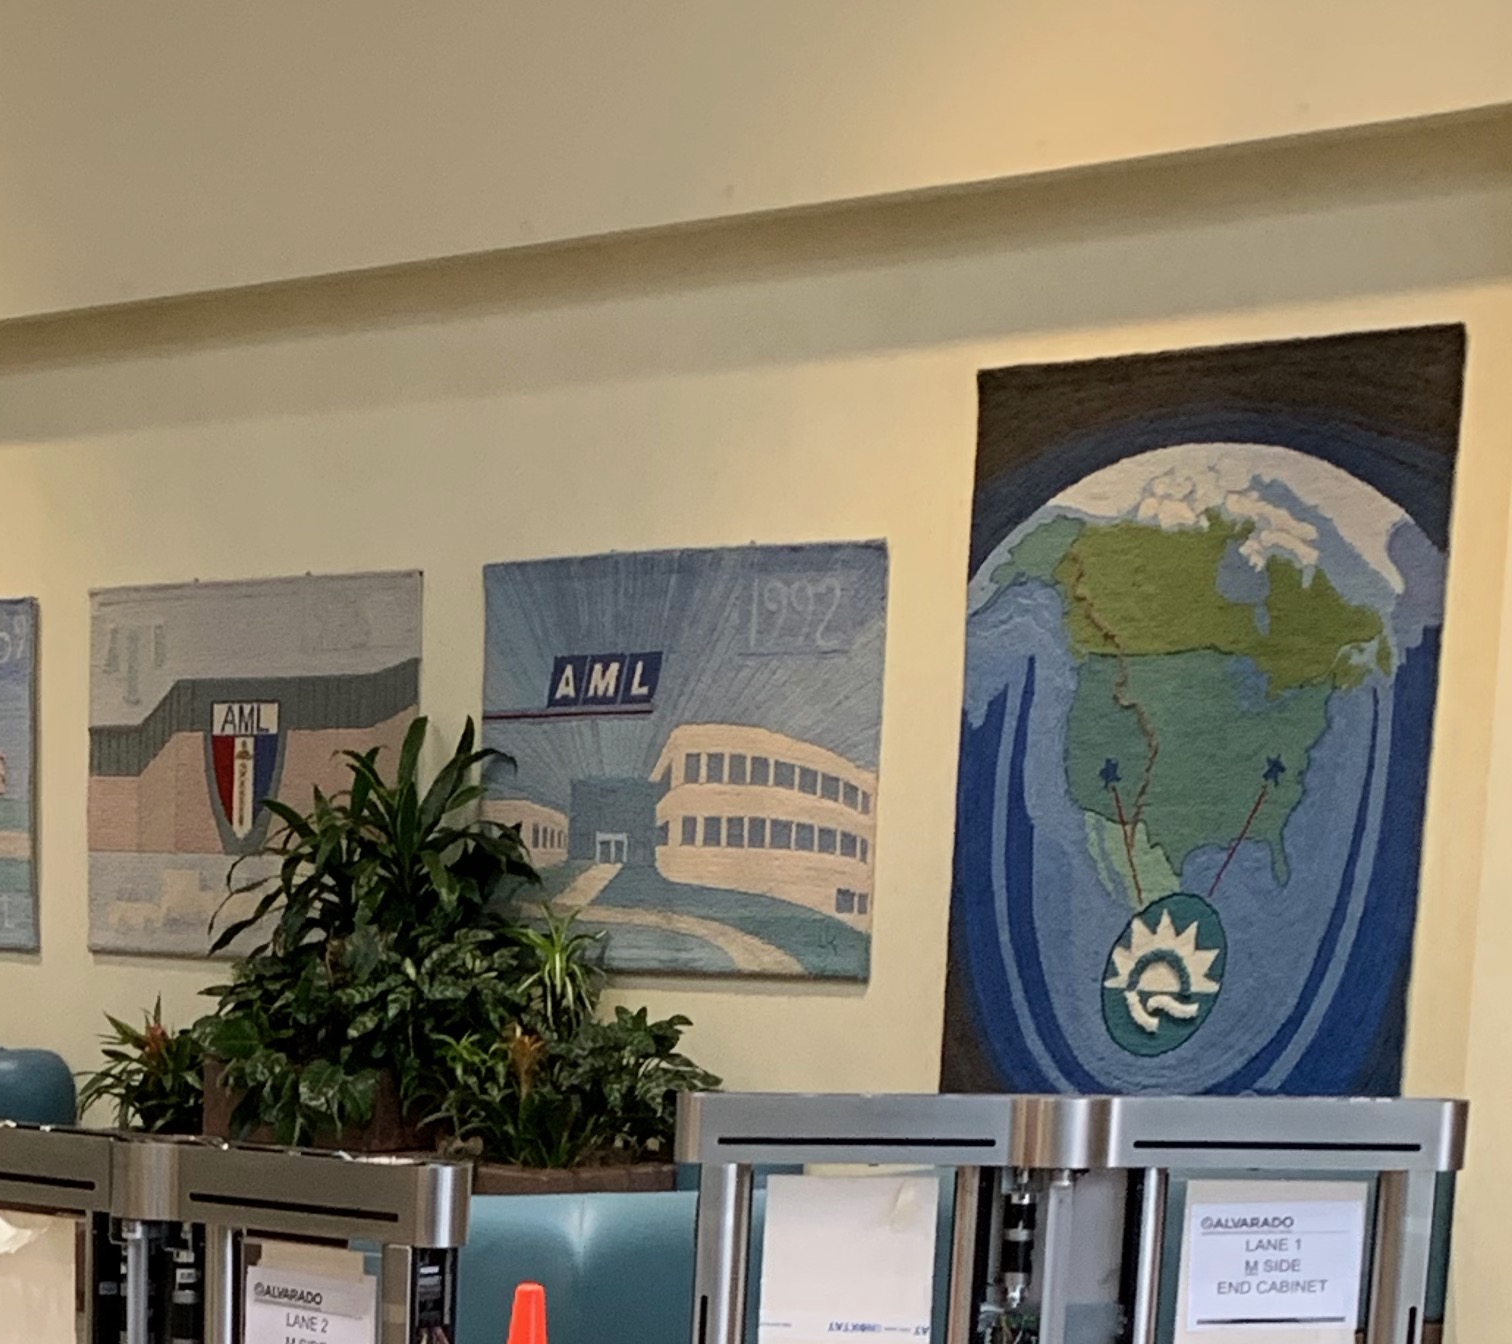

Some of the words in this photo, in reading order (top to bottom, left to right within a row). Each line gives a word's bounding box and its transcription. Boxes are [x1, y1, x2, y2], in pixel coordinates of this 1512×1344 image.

[750, 576, 845, 648] 1992
[221, 703, 269, 733] AML
[1214, 1216, 1294, 1229] ALVARADO
[1245, 1238, 1288, 1252] LANE
[1295, 1238, 1301, 1250] 1
[1245, 1259, 1258, 1274] M
[1263, 1258, 1301, 1273] SIDE
[264, 1284, 323, 1305] ALVARADO
[1217, 1281, 1251, 1294] END
[1256, 1279, 1328, 1294] CABINET
[286, 1312, 318, 1332] LANE
[321, 1318, 329, 1333] 2
